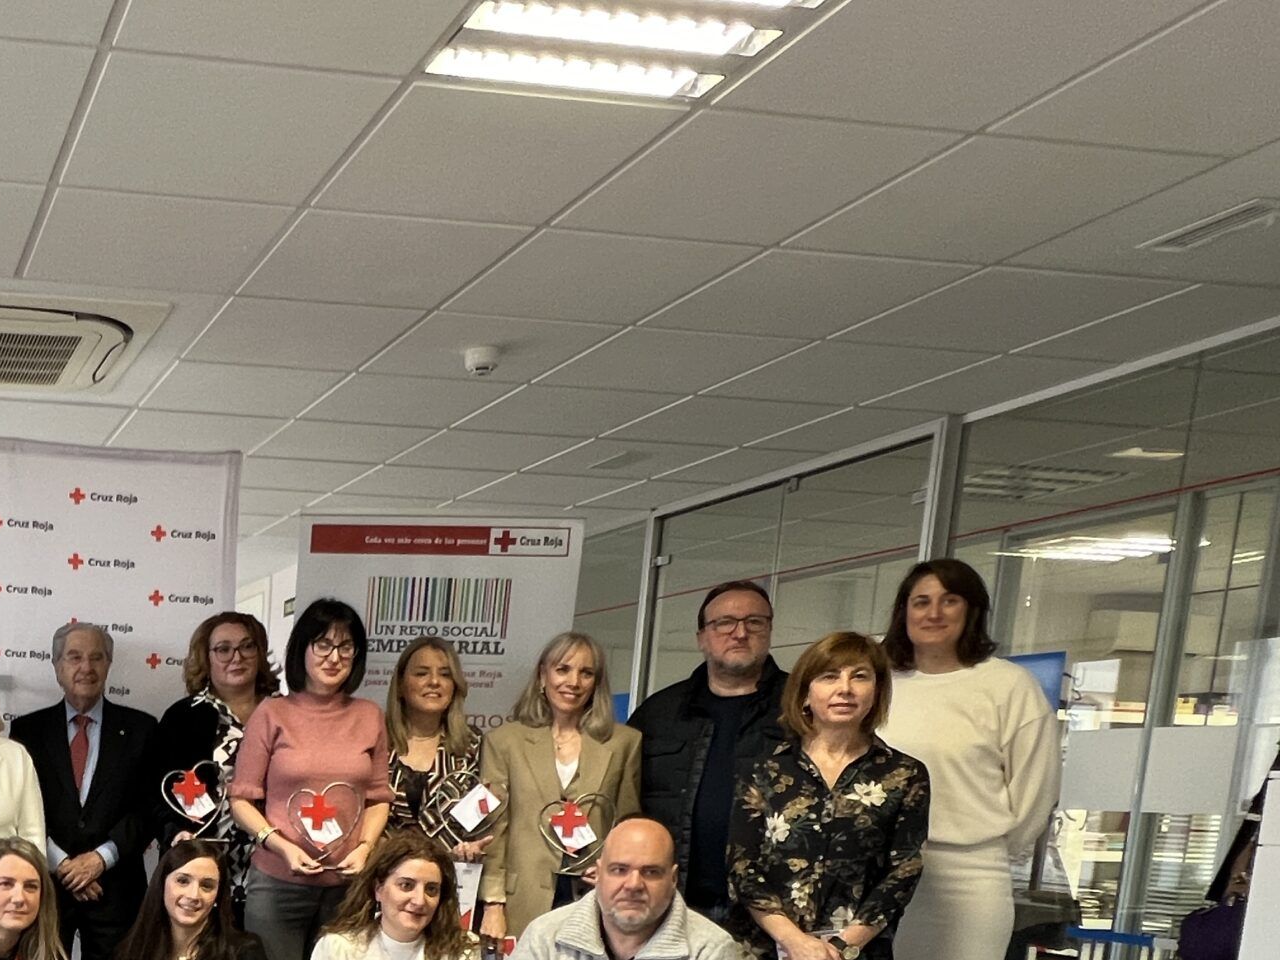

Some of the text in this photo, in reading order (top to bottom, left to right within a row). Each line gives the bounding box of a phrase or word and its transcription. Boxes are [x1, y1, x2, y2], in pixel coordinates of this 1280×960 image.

[90, 492, 138, 506] Cruz Roja
[6, 518, 54, 533] Cruz Roja
[170, 529, 216, 543] Cruz Roja
[520, 536, 563, 548] Cruz Roja
[87, 557, 136, 571] Cruz Roja
[5, 584, 53, 597] Cruz Roja
[167, 593, 214, 606] Cruz Roja
[111, 623, 134, 634] Roja
[375, 625, 498, 638] UN RETO SOCIAL
[4, 648, 51, 662] Cruz Roja
[165, 656, 183, 666] Cru
[478, 670, 503, 680] Roja
[108, 685, 131, 697] Roja
